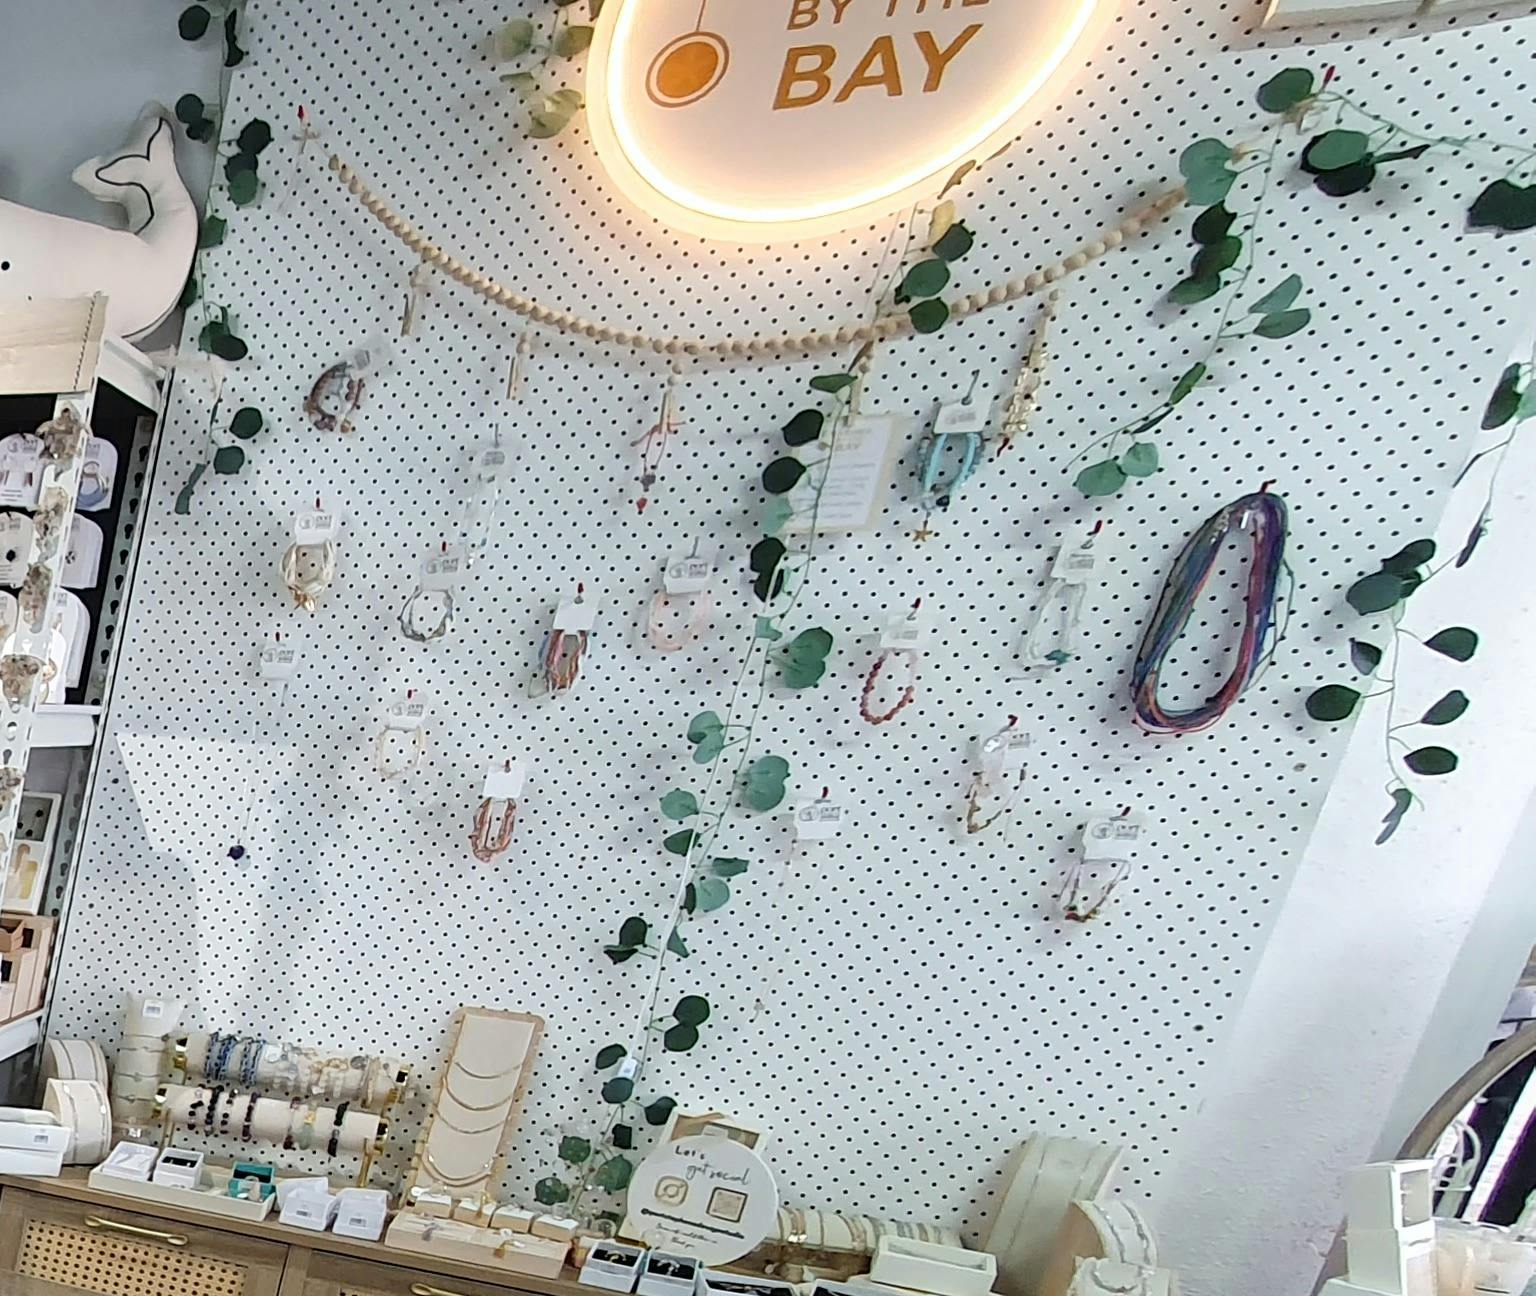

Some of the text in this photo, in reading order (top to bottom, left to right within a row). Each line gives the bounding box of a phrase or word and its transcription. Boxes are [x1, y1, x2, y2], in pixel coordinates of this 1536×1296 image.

[786, 0, 853, 30] BY
[772, 23, 984, 111] BAY
[685, 1163, 710, 1180] get
